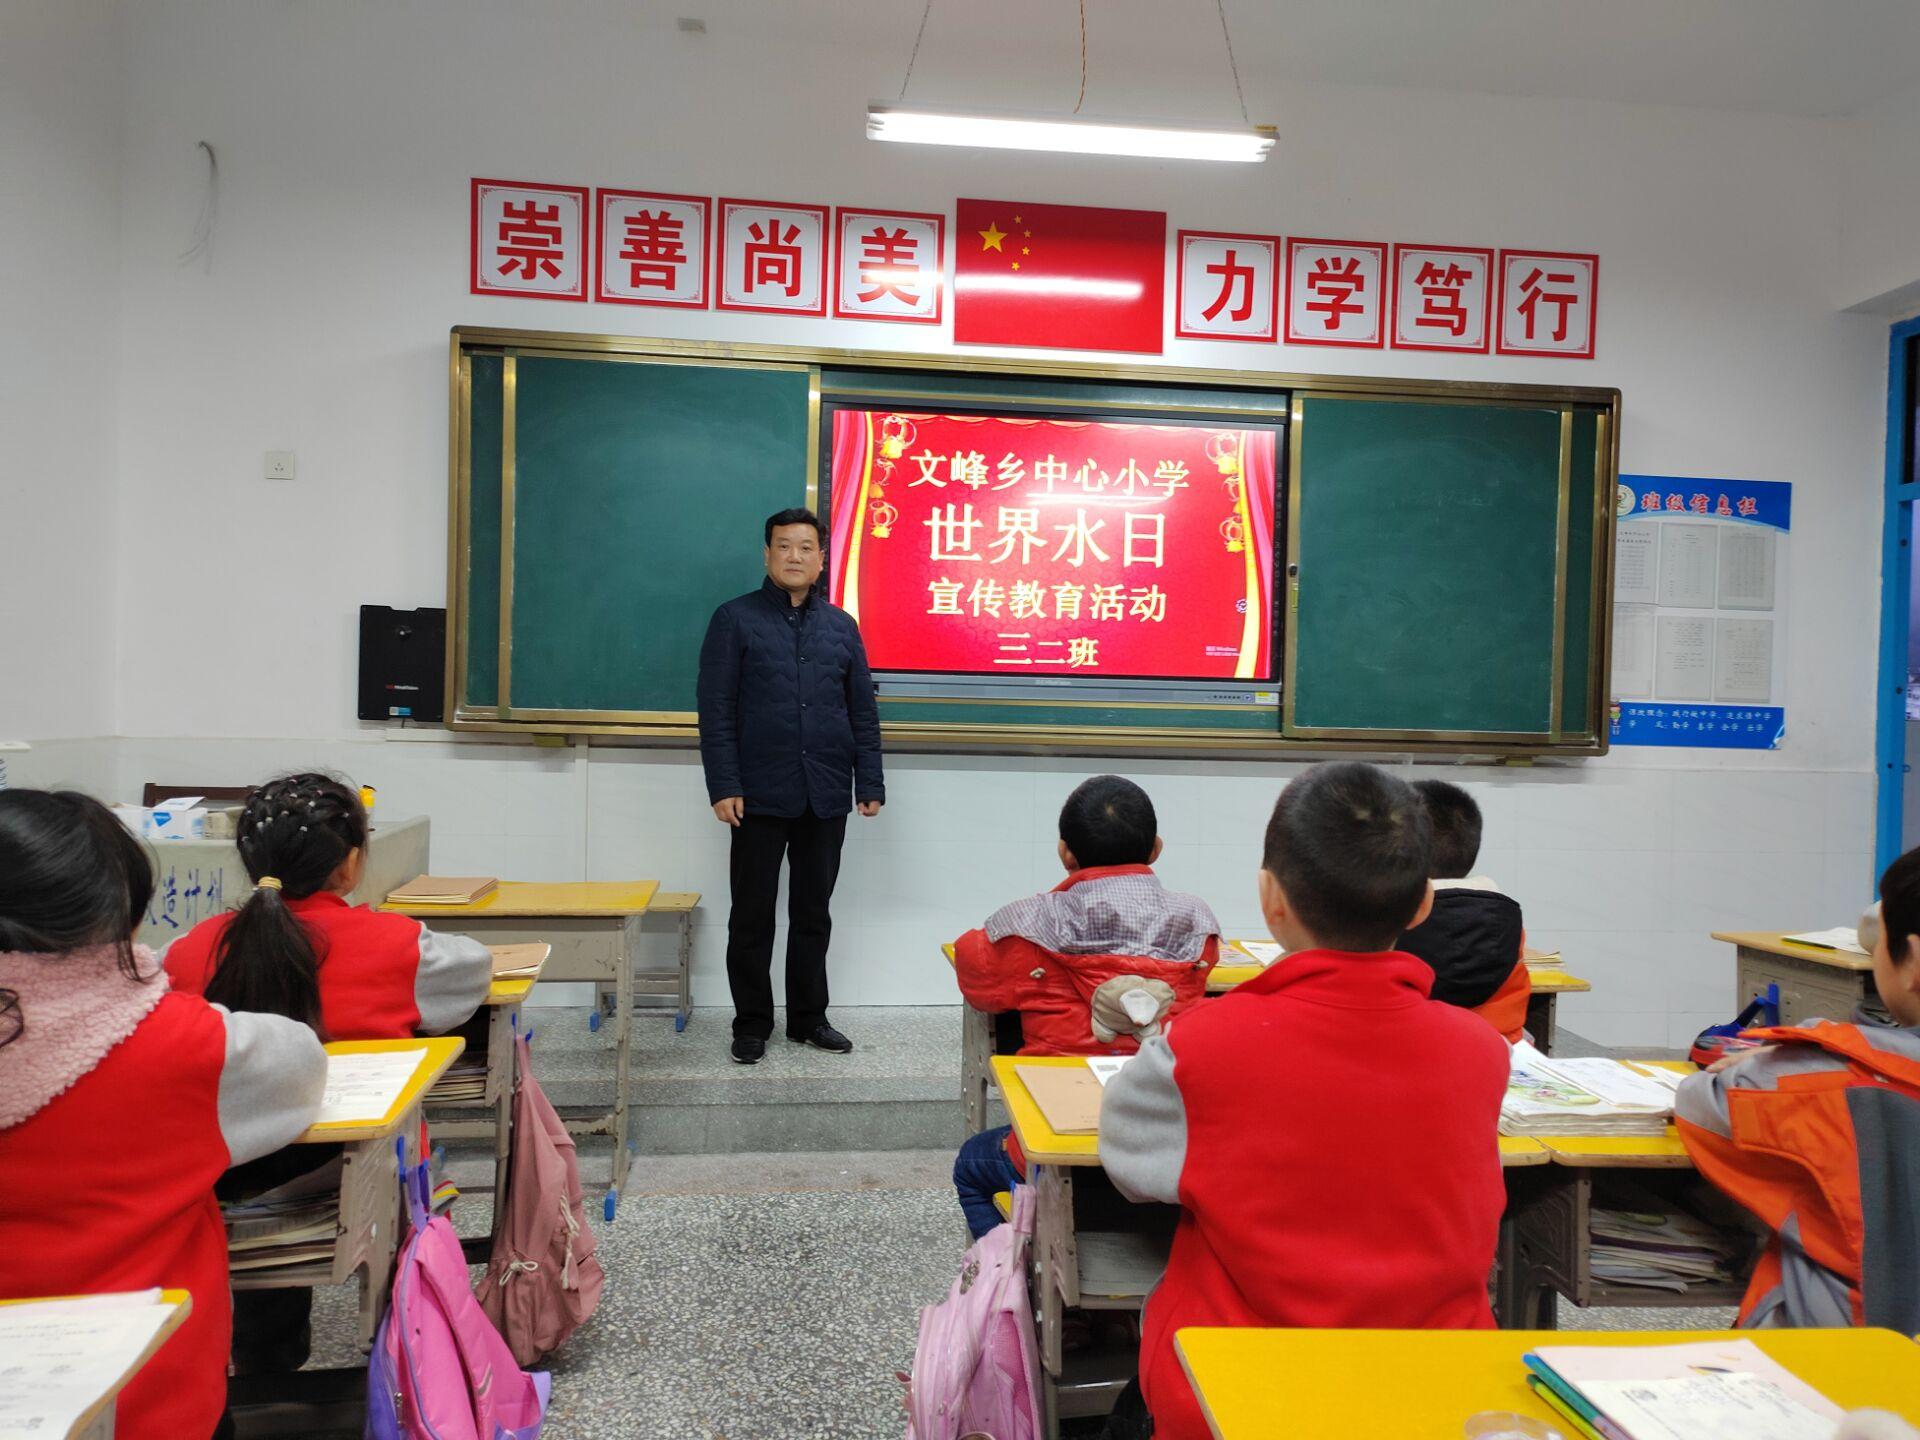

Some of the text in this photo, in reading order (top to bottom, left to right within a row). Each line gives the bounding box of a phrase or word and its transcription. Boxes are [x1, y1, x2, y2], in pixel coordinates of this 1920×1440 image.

[496, 200, 920, 306] 崇善尚美
[1201, 249, 1578, 342] 力学笃行
[907, 449, 1190, 498] 文峰乡中心小学
[1641, 491, 1758, 516] 班级信息栏
[923, 503, 1166, 568] 世界水日
[926, 576, 1167, 622] 宣传教育活动
[993, 632, 1099, 667] 三二班
